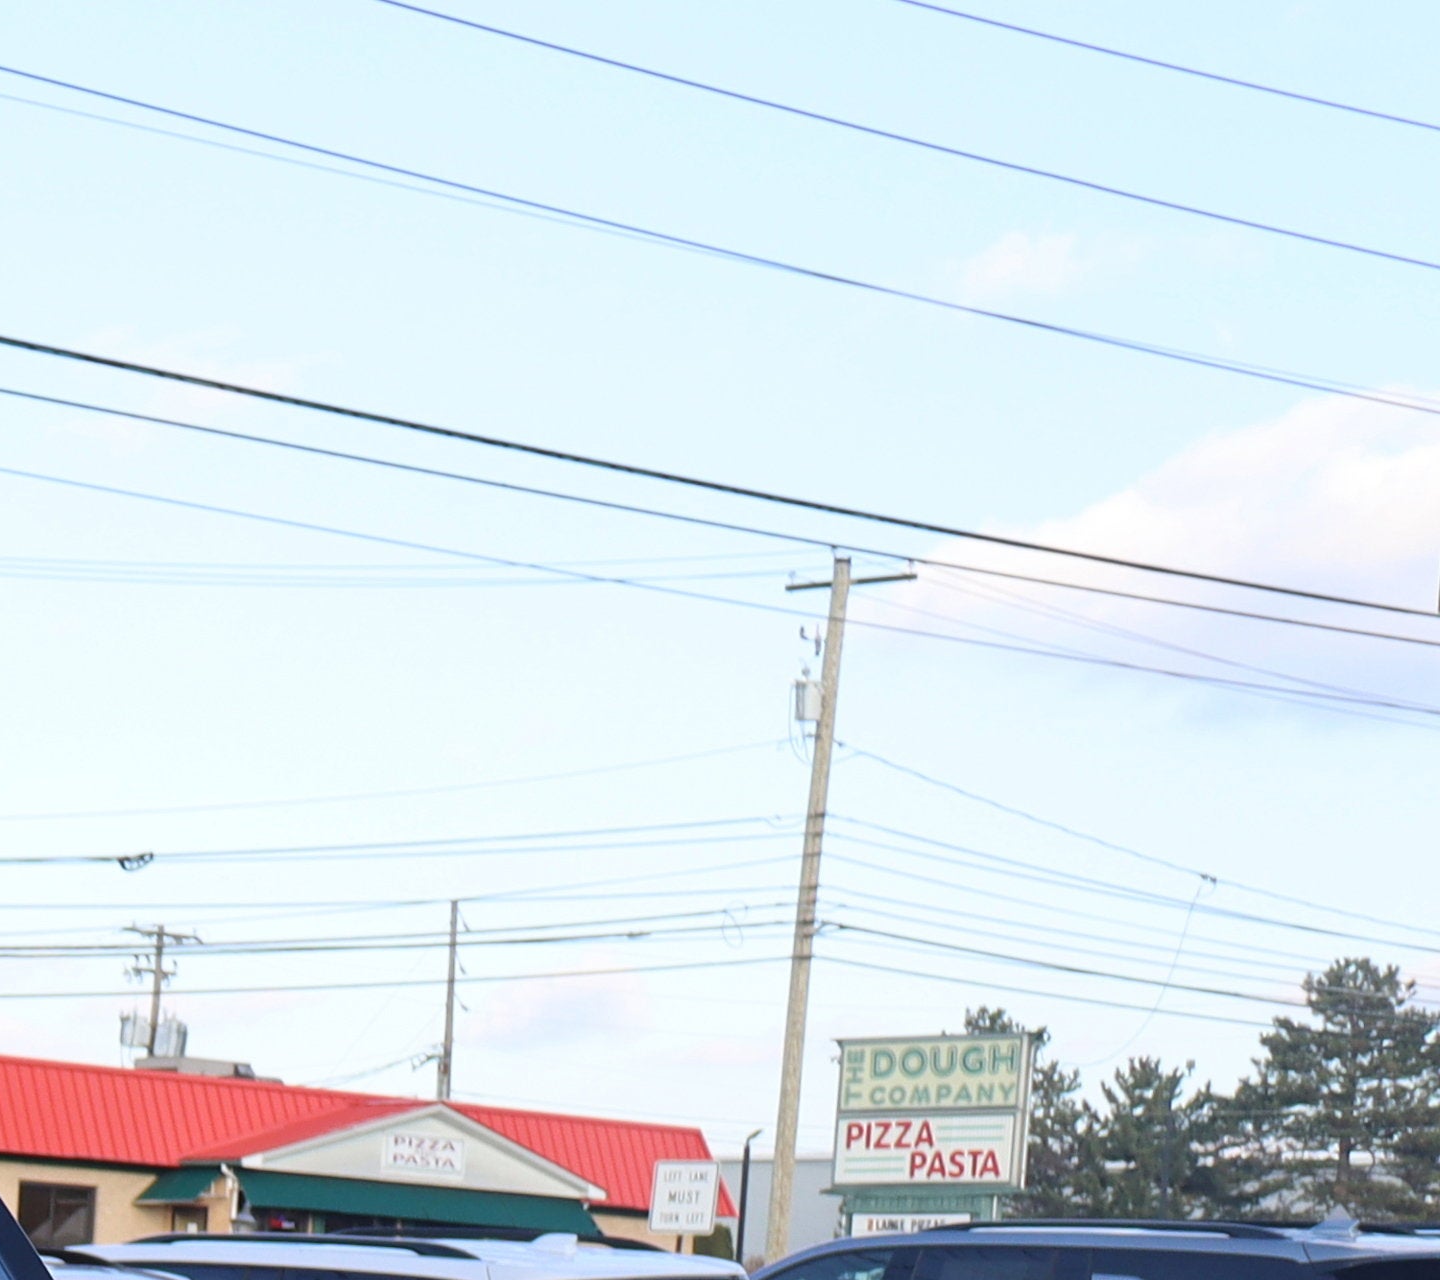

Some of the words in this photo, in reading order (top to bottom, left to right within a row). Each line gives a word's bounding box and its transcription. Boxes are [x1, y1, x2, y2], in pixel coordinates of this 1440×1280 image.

[870, 1042, 1018, 1079] DOUGH
[845, 1049, 865, 1106] THE
[869, 1083, 1015, 1105] COMPANY
[393, 1135, 455, 1151] PIZZA
[845, 1120, 934, 1149] PIZZA
[393, 1153, 455, 1169] PASTA
[909, 1150, 1000, 1178] PASTA
[668, 1190, 700, 1204] MUST
